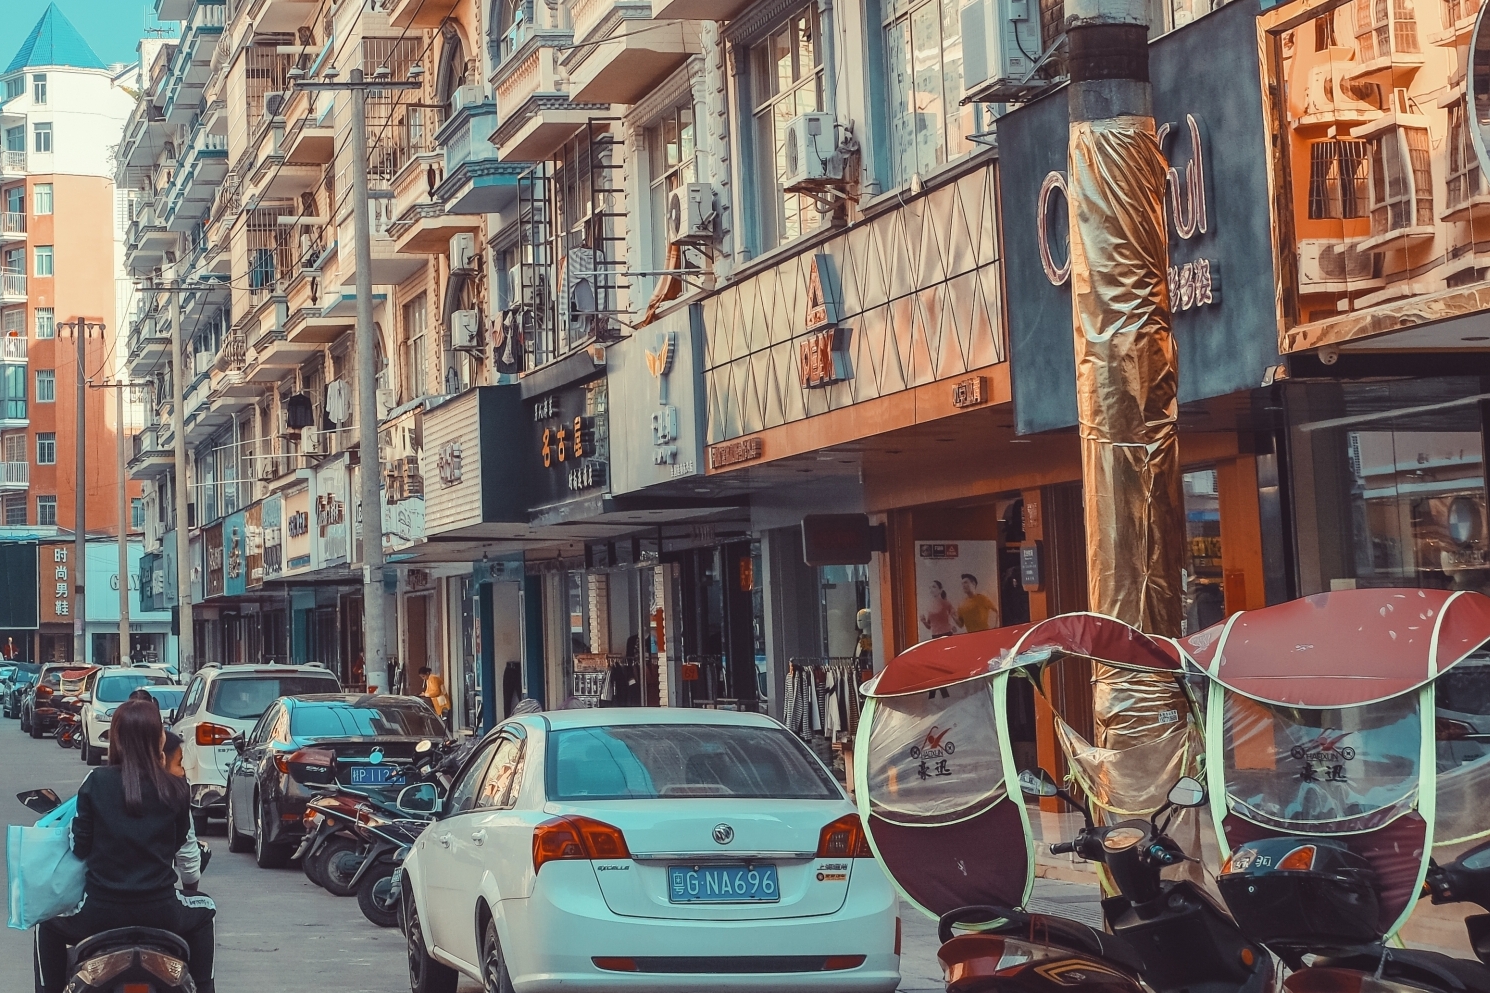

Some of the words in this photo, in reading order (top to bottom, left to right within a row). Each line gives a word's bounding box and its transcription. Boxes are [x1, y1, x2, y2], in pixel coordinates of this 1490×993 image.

[542, 416, 583, 468] 名古屋
[54, 547, 70, 616] 时尚男鞋
[918, 759, 952, 780] 豪迅
[1300, 762, 1347, 783] 豪迅
